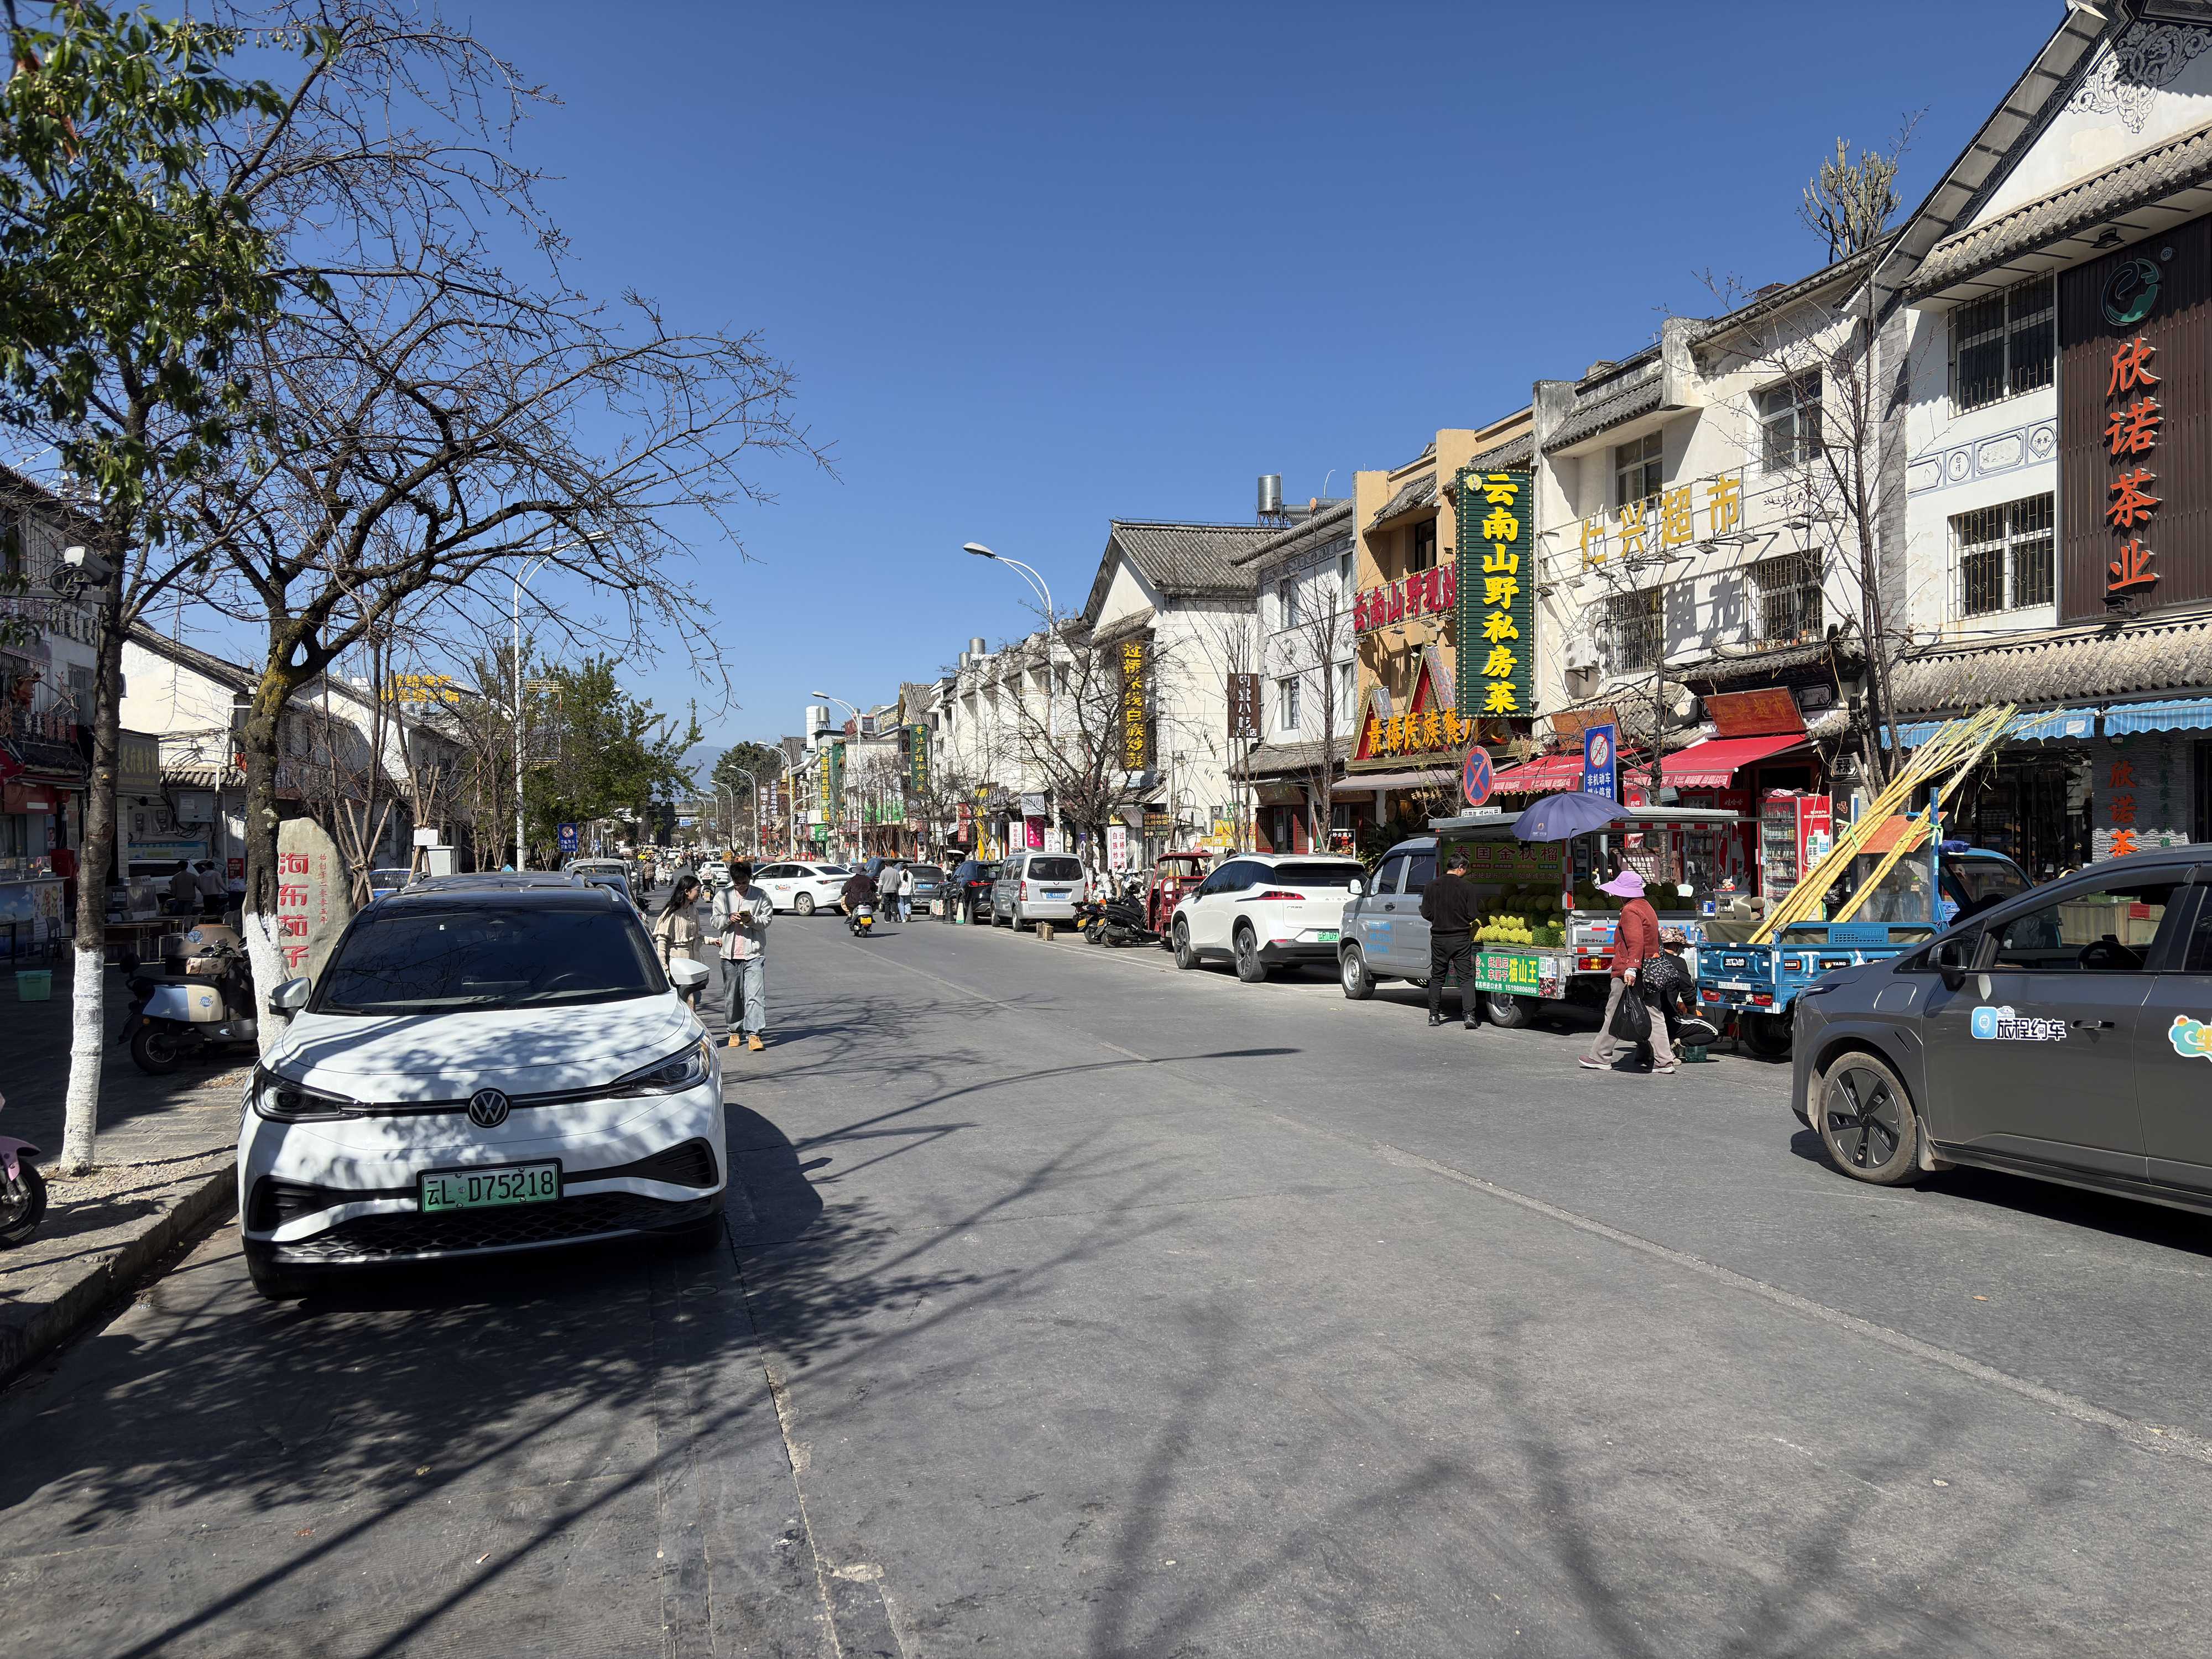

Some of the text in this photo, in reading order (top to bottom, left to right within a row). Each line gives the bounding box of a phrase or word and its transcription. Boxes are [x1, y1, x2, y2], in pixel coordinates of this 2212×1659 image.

[2105, 338, 2159, 591] 欣诺茶业
[1579, 474, 1741, 571] 仁兴超市
[1481, 473, 1520, 714] 云南山野私房菜
[1367, 707, 1471, 755] 景傣民族餐
[1587, 772, 1611, 786] 非机动车
[1836, 759, 1851, 774] 禄
[2107, 760, 2138, 858] 欣诺茶
[318, 853, 328, 925] 始创于二零零五年
[1505, 984, 1537, 994] 15198806096
[1509, 958, 1537, 983] 猫山王
[1997, 1019, 2067, 1041] 旅程约车
